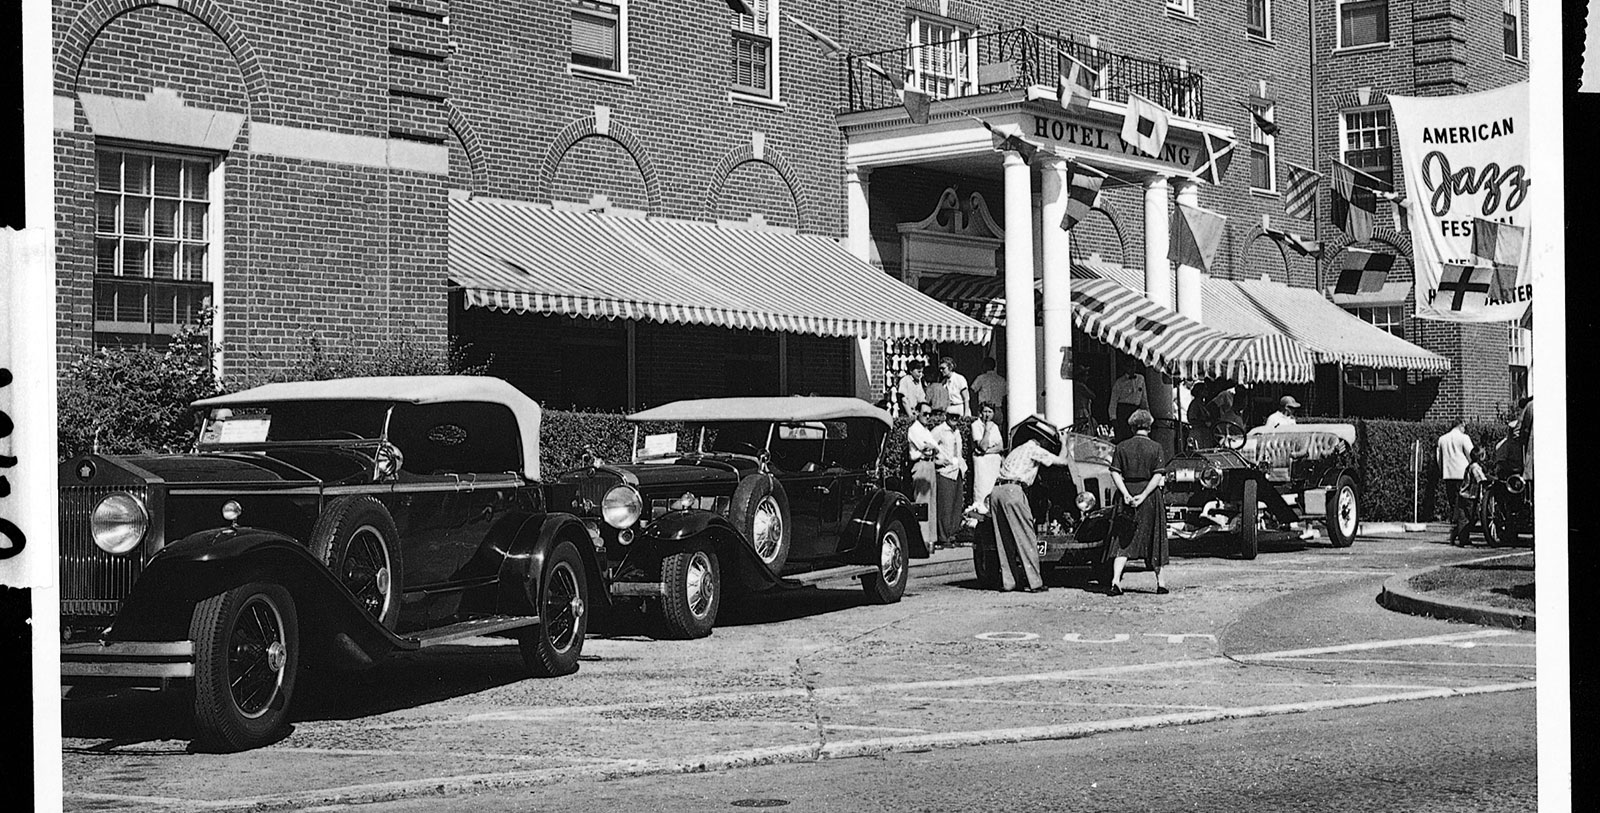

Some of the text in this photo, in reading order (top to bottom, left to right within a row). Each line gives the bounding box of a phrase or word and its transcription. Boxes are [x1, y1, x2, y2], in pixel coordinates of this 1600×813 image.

[1034, 116, 1191, 166] HOTEL VNG
[1423, 117, 1514, 144] AMERICAN
[1421, 150, 1531, 217] Jazz
[975, 631, 1217, 643] OUT
